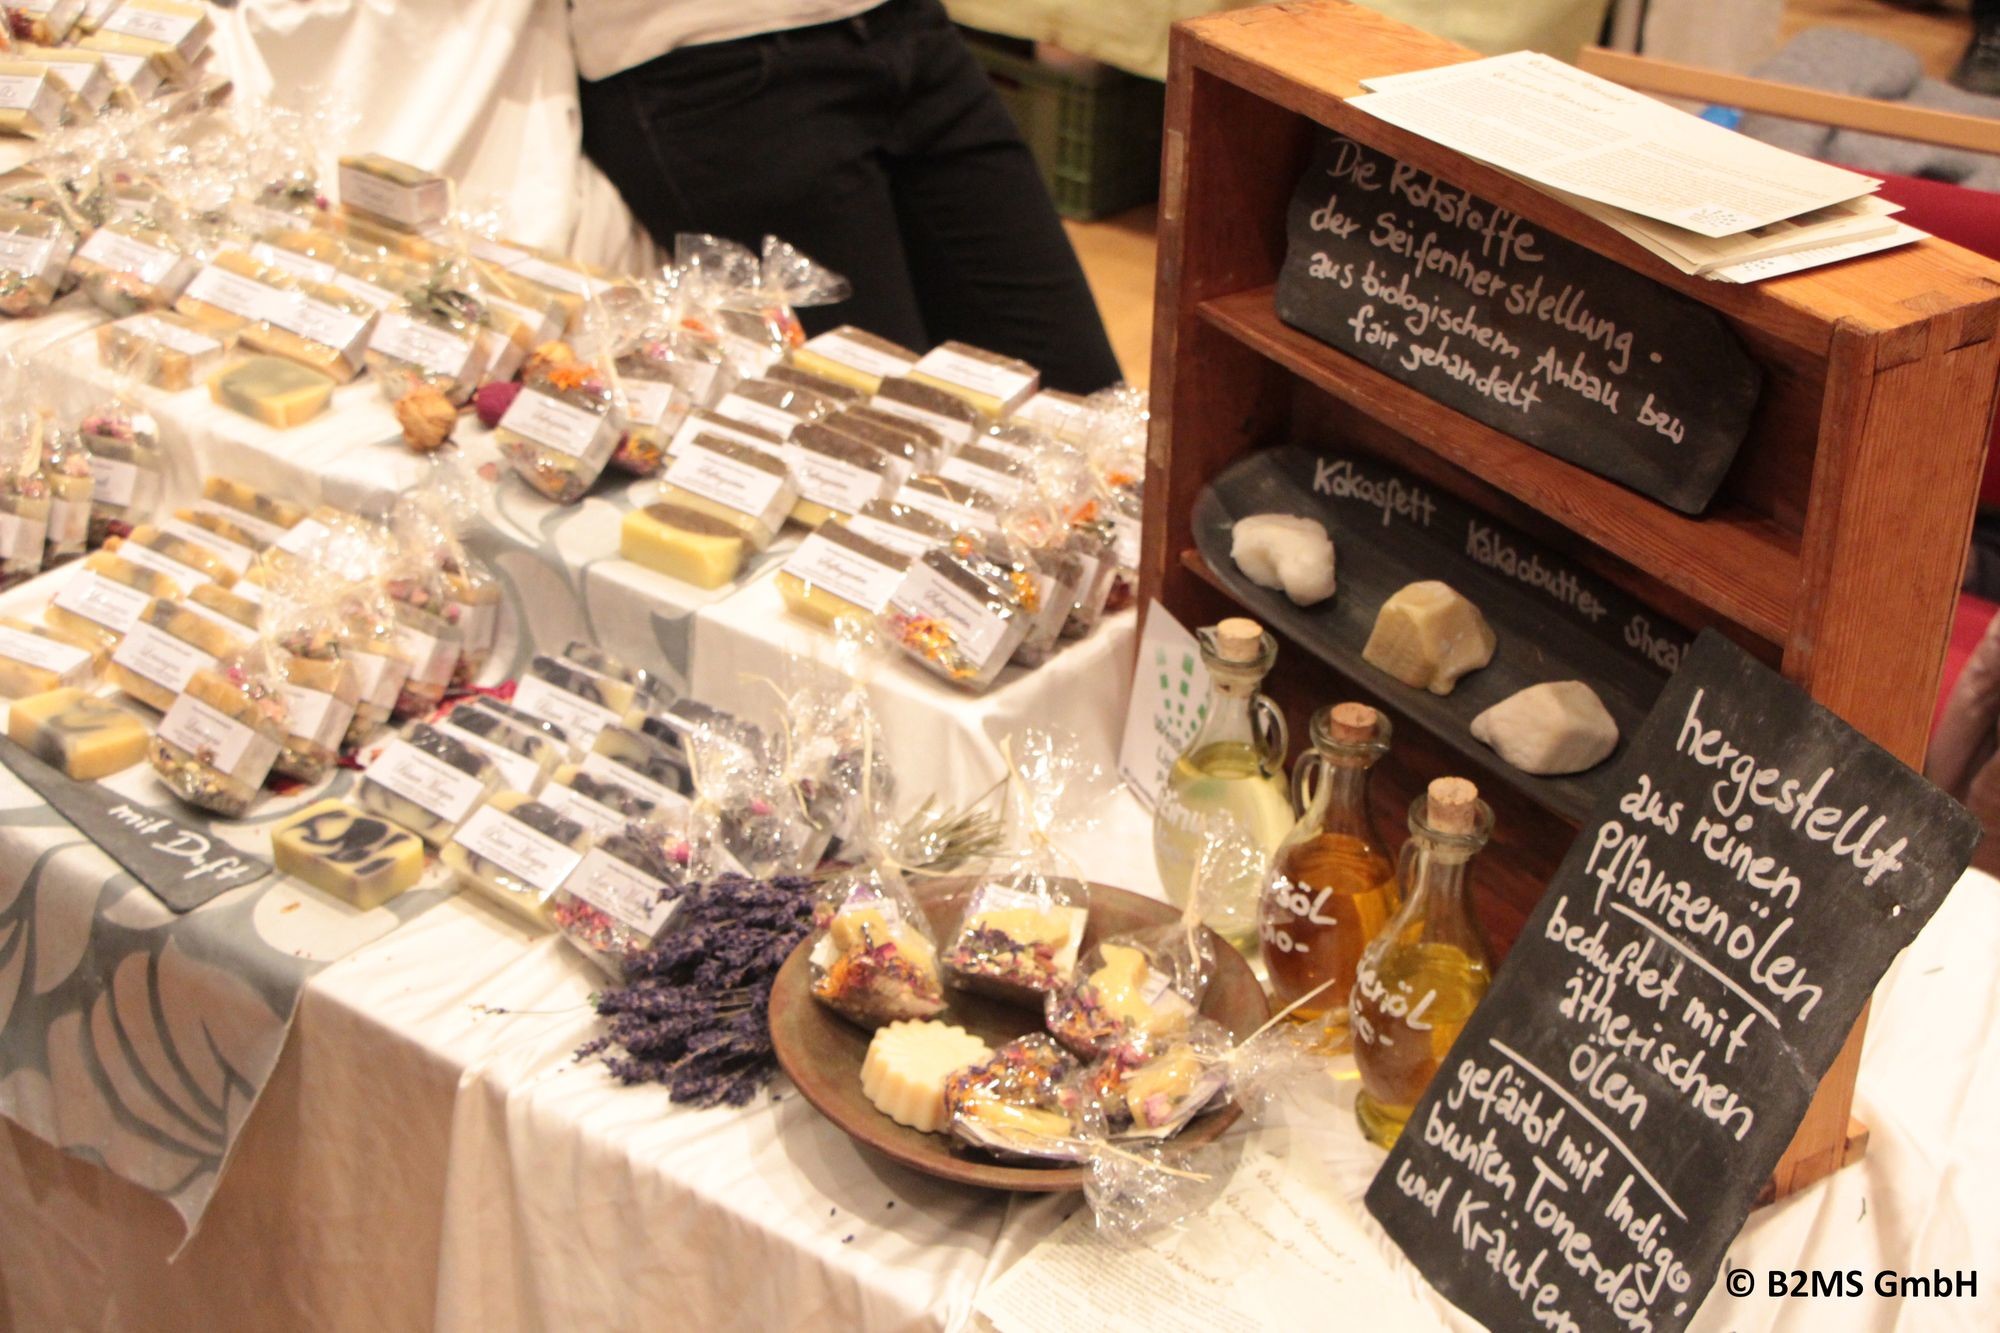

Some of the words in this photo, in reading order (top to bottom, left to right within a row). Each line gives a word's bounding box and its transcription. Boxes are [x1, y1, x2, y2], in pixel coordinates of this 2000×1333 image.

[1310, 195, 1361, 240] der
[1326, 137, 1381, 191] Die
[1390, 160, 1545, 267] Rohstoffe
[1308, 251, 1353, 288] aus
[1362, 262, 1520, 359] biologischem
[1531, 346, 1619, 414] Anbau
[1636, 394, 1686, 444] bzw
[1348, 305, 1398, 350] fair
[1399, 338, 1543, 413] gehandelt
[1313, 457, 1437, 526] Kokosfett
[1465, 519, 1608, 623] Kakaobutter
[108, 804, 172, 834] mit
[151, 830, 250, 880] Duft
[1619, 774, 1685, 835] aus
[1691, 815, 1801, 909] reinen
[1676, 688, 1908, 886] hergestellt
[1545, 896, 1684, 1011] beduftet
[1682, 997, 1756, 1064] mit
[1584, 821, 1823, 1021] Pflanzenölen
[1559, 967, 1754, 1141] ätherischen
[1569, 1033, 1647, 1130] Ölen
[1396, 1158, 1452, 1218] und
[1424, 1101, 1516, 1200] bunten
[1447, 1059, 1565, 1147] gefärbt
[1557, 1135, 1609, 1193] mit
